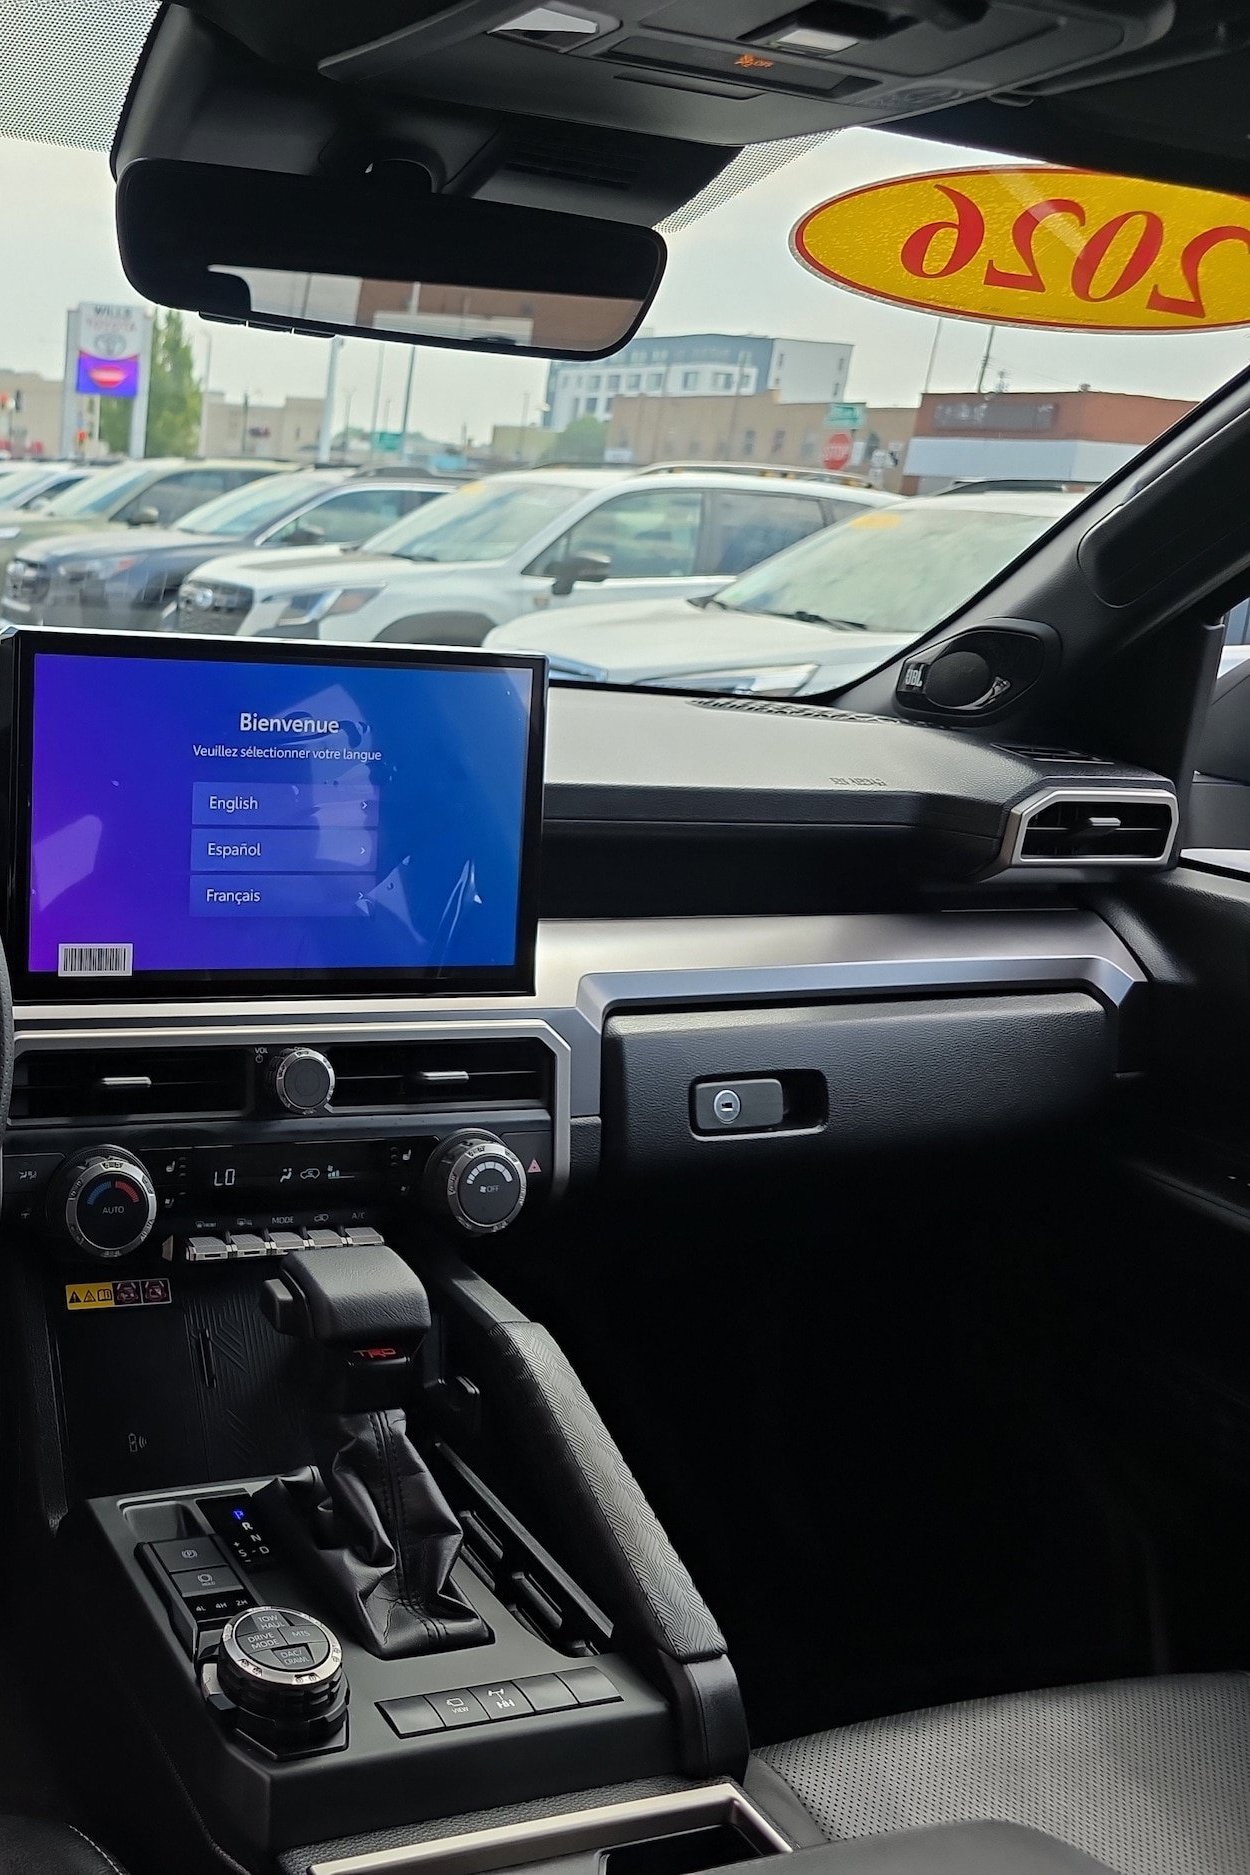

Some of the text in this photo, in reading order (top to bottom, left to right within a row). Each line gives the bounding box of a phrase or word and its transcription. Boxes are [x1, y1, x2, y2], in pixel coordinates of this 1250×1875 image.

[905, 664, 923, 687] JBL
[239, 712, 340, 733] Bienvenue
[192, 745, 382, 763] Veuillez sélectionner votre langue
[209, 796, 259, 813] English
[207, 842, 262, 859] Español
[206, 888, 261, 905] Français
[486, 1185, 500, 1193] OFF
[102, 1205, 125, 1214] AUTO
[271, 1216, 294, 1224] MODE
[351, 1211, 366, 1219] A/C
[353, 1348, 397, 1359] TRD
[233, 1509, 244, 1520] P
[241, 1522, 253, 1531] R
[250, 1533, 262, 1542] N
[258, 1545, 270, 1554] D
[257, 1614, 279, 1623] TOW
[261, 1621, 286, 1630] HAUL
[247, 1631, 275, 1643] DRIVE
[291, 1630, 311, 1638] MTS
[251, 1639, 280, 1650] MODE
[280, 1648, 302, 1659] DAC/
[283, 1656, 310, 1666] CRAWL
[451, 1706, 470, 1714] VIEW
